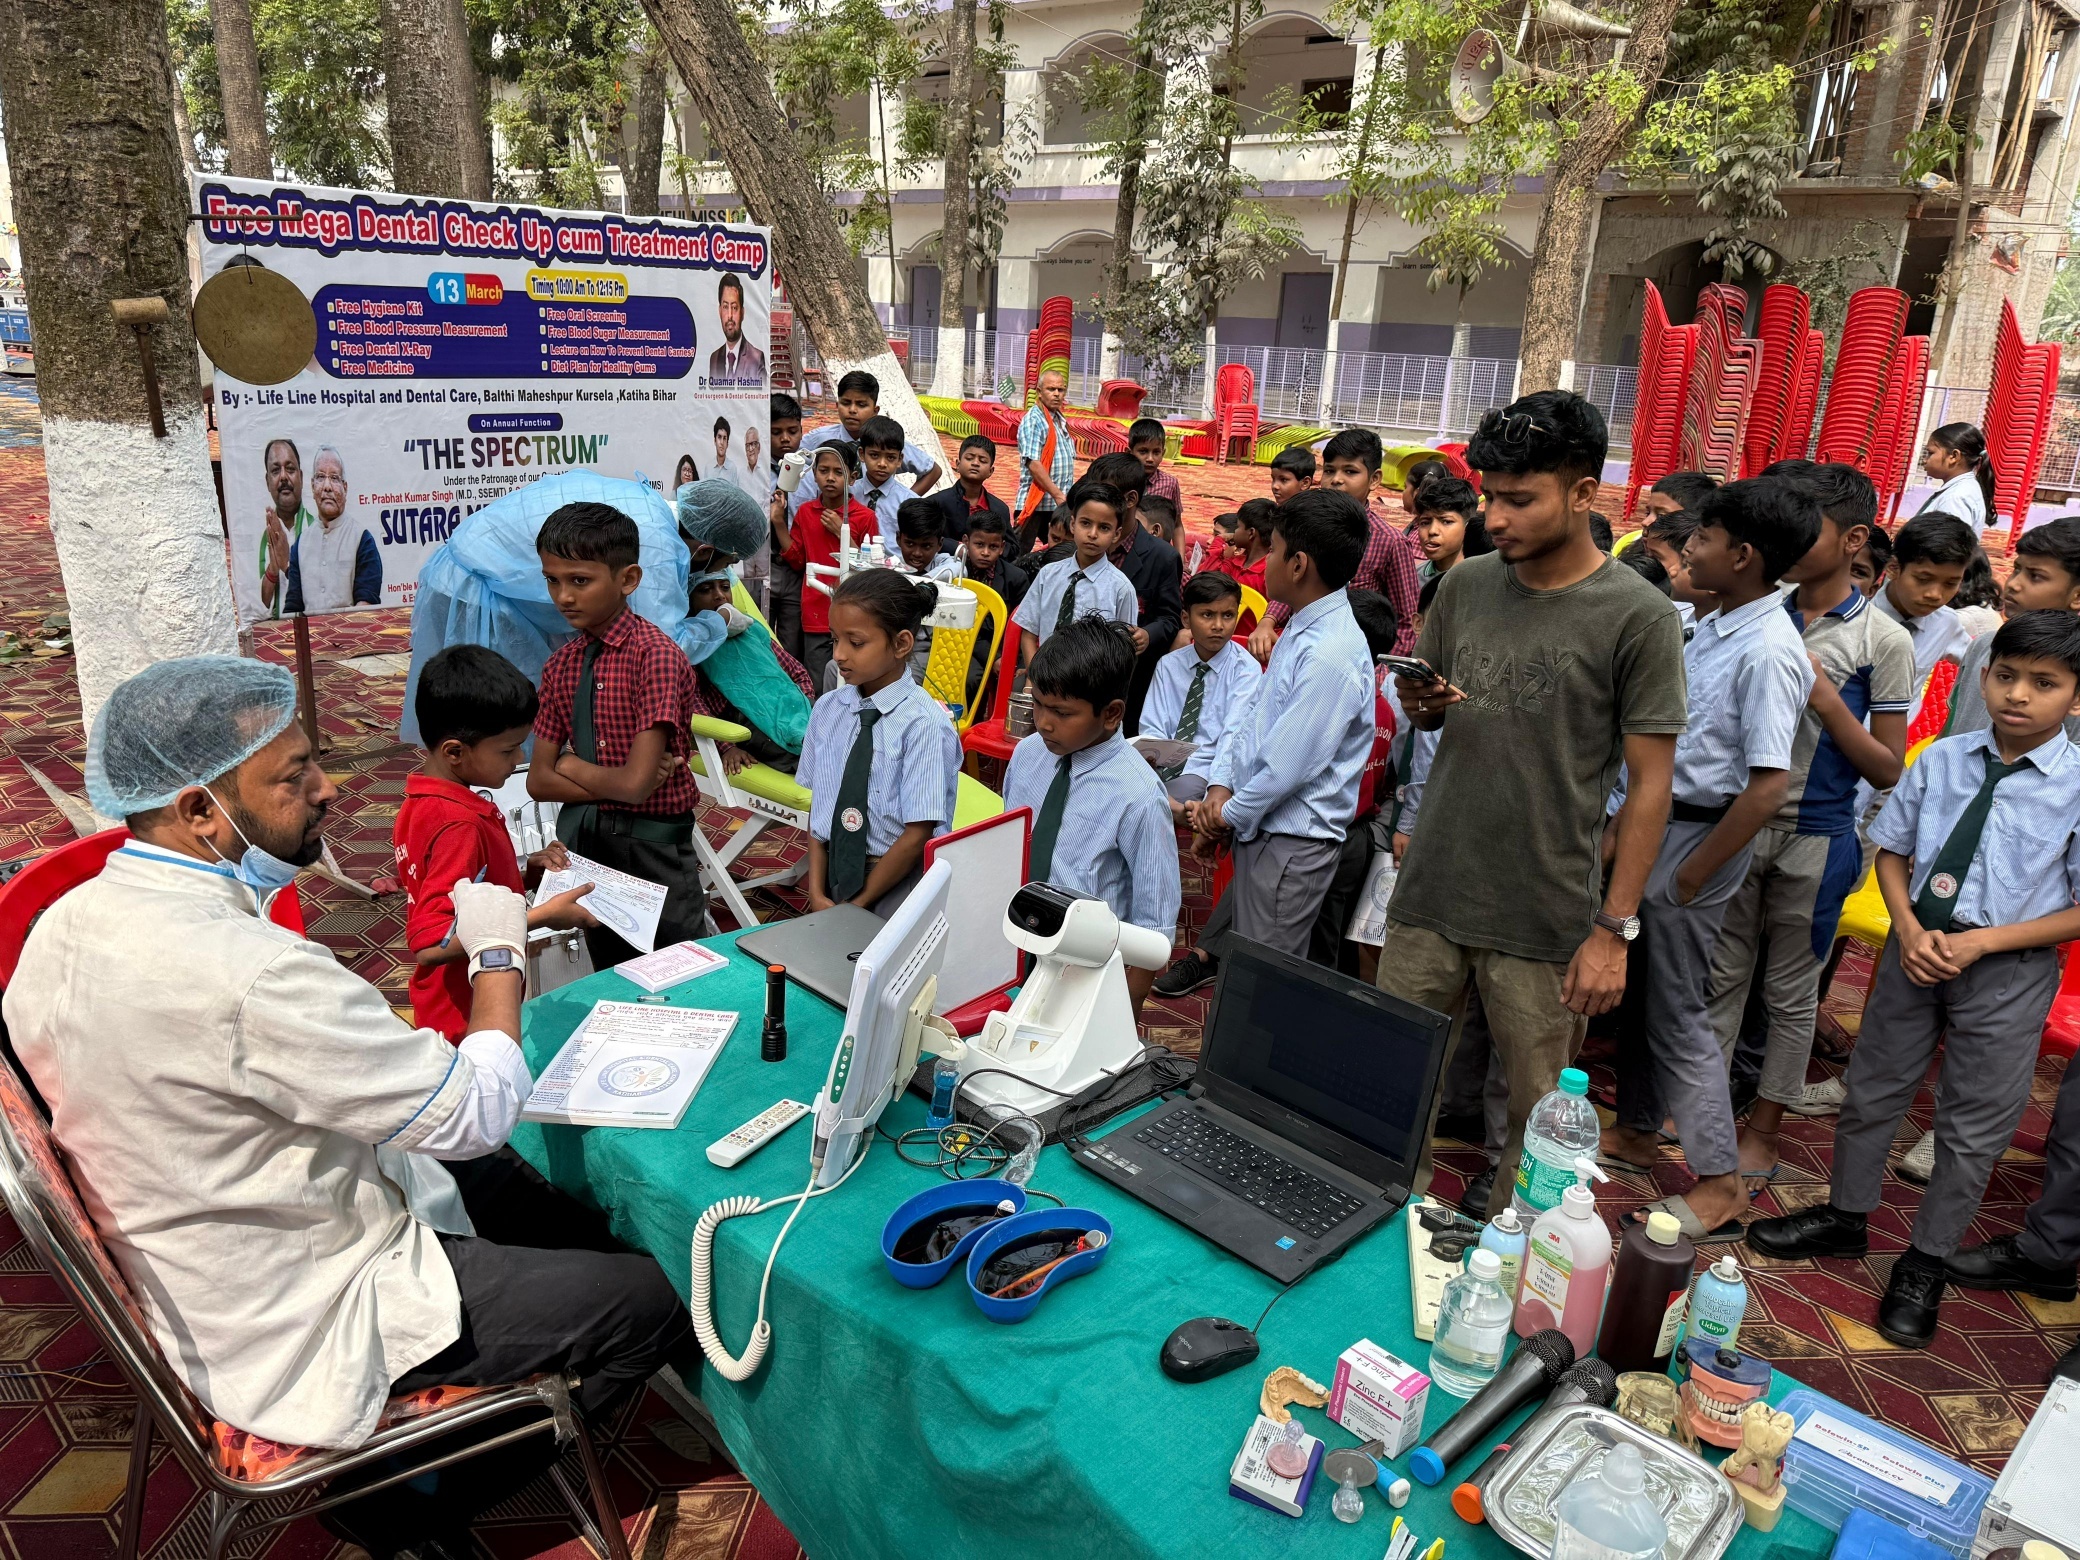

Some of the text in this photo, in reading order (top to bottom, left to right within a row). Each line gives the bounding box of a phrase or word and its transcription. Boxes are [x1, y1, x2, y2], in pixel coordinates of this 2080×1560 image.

[208, 195, 765, 271] Free Mega Dental Check Up cum Treatment Camp
[435, 278, 503, 303] 13 March
[531, 277, 624, 298] Timing 10:00 Am To 12:15 Pm
[335, 299, 423, 317] Free Hygiene Kit
[547, 308, 626, 325] Free Oral Screening
[337, 320, 507, 338] Free Blood Pressure Measurement
[548, 326, 670, 341] Free Blood Sugar Measurement
[340, 341, 432, 359] Free Dental X-Ray
[550, 343, 579, 355] Lecture
[580, 347, 589, 355] on
[590, 344, 606, 355] How
[607, 345, 617, 355] To
[617, 345, 644, 357] Prevent
[645, 346, 667, 357] Dental
[341, 360, 414, 375] Free Medicine
[551, 360, 656, 375] Diet Plan for Healthy Gums
[699, 376, 762, 387] Dr Quamar Hashmi
[222, 390, 239, 408] By
[244, 393, 253, 405] :-
[257, 389, 284, 404] Life
[288, 389, 317, 404] Line
[321, 389, 375, 407] Hospital
[379, 388, 402, 403] and
[406, 388, 446, 403] Dental
[450, 389, 481, 405] Care,
[483, 389, 515, 402] Balthi
[518, 389, 573, 405] Maheshpur
[576, 389, 613, 401] Kursela
[652, 389, 677, 401] Bihar
[480, 418, 551, 428] On Annual Function
[443, 476, 465, 486] Under
[467, 475, 479, 485] the
[481, 474, 517, 486] Patronage
[519, 473, 526, 482] of
[529, 474, 540, 482] our
[359, 494, 370, 505] Er.
[372, 493, 403, 504] Prabhat
[405, 492, 430, 503] Kumar
[432, 490, 453, 502] Singh
[456, 489, 477, 502] (M.D.,
[478, 487, 506, 499] SSEMT)
[388, 584, 412, 593] Hon'ble
[1451, 636, 1581, 714] CRAZY
[1548, 1232, 1560, 1244] 3M
[1705, 1300, 1732, 1315] Topical
[1371, 1366, 1391, 1380] Zinc
[1355, 1379, 1376, 1398] Zinc
[1361, 1397, 1379, 1412] Phosphate
[1379, 1410, 1393, 1421] Cement
[1924, 1475, 1946, 1490] Plus
